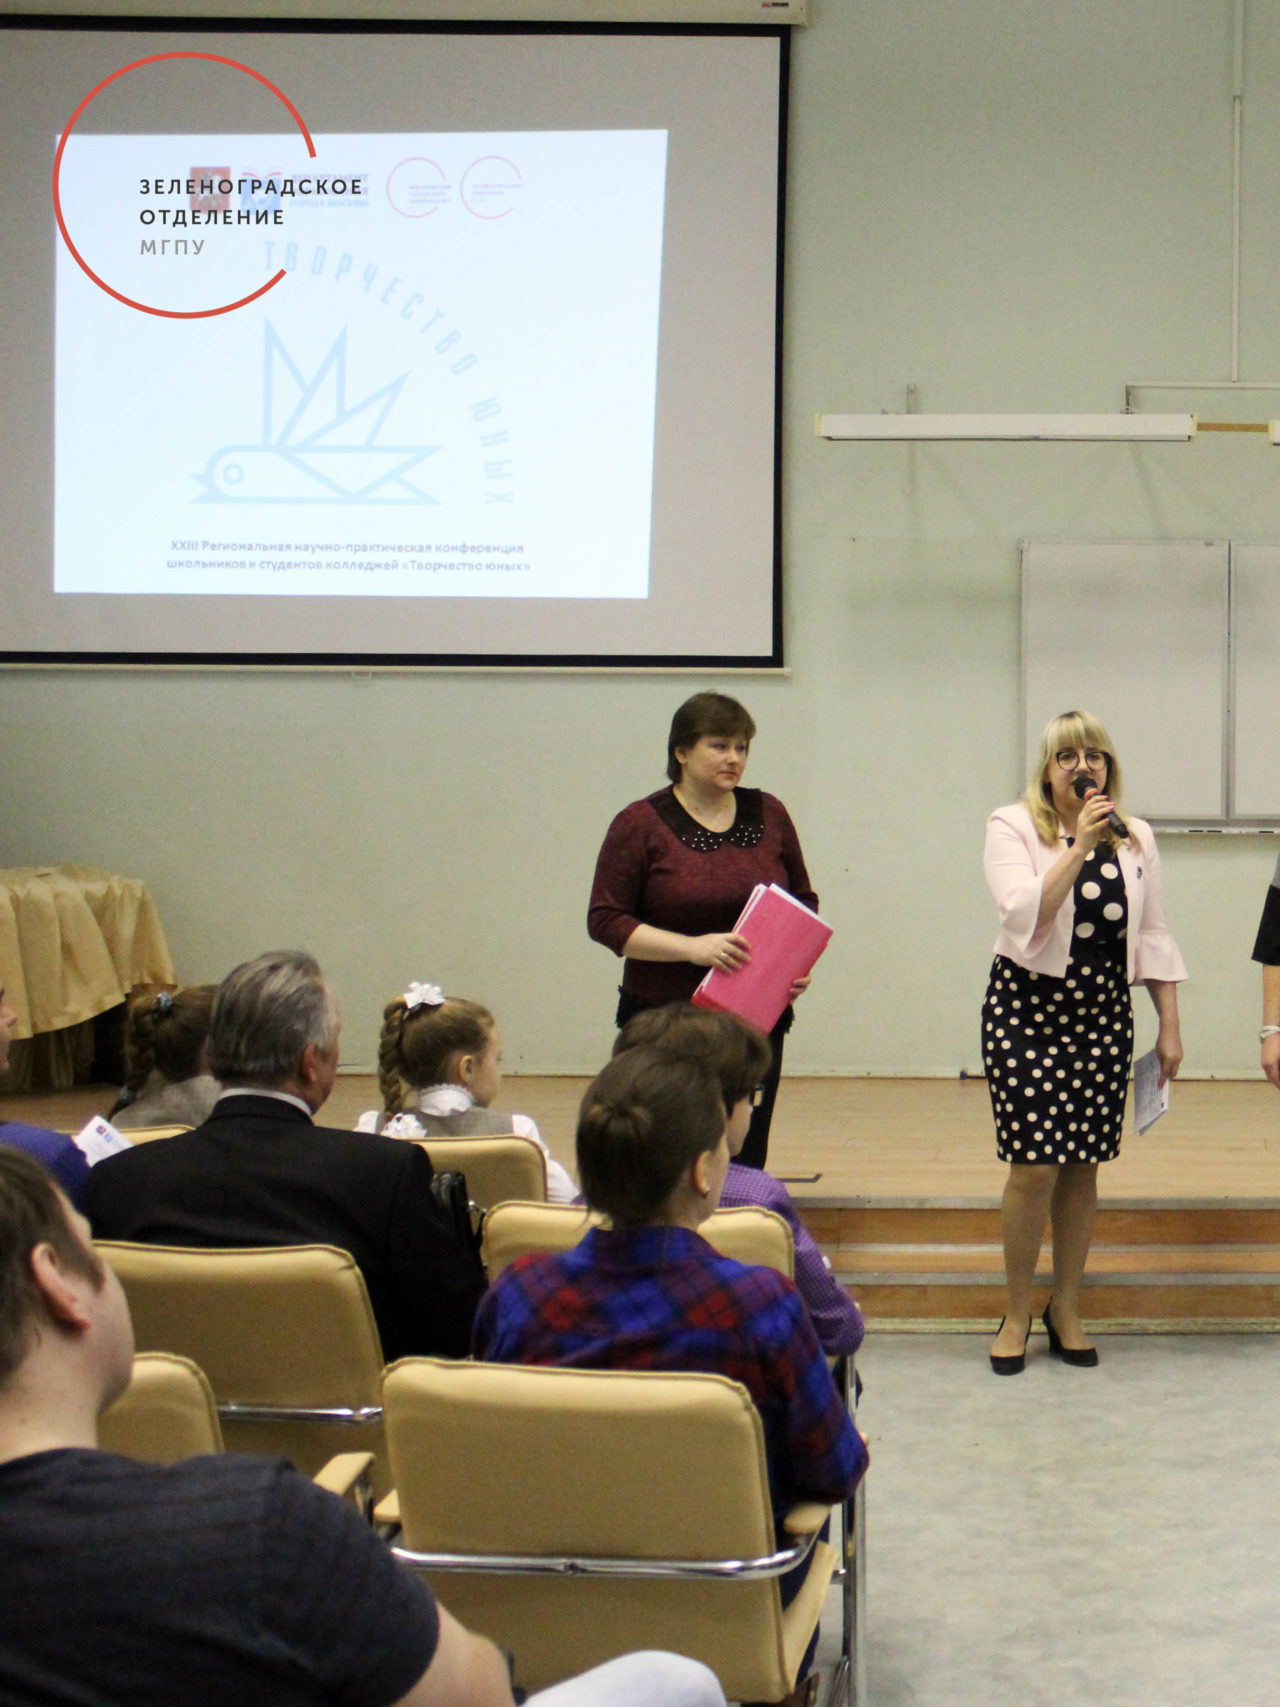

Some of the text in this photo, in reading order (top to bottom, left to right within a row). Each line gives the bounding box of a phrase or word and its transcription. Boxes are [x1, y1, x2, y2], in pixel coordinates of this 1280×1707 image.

[263, 240, 480, 377] ТВОРЧЕСТВО
[468, 394, 516, 505] ЮНЫХ
[202, 540, 292, 553] Региональная
[294, 542, 432, 556] научно-практическая
[435, 541, 524, 556] конференция
[166, 559, 247, 569] школьников
[248, 560, 256, 569] и
[259, 559, 323, 573] студентов
[326, 559, 399, 573] колледжей
